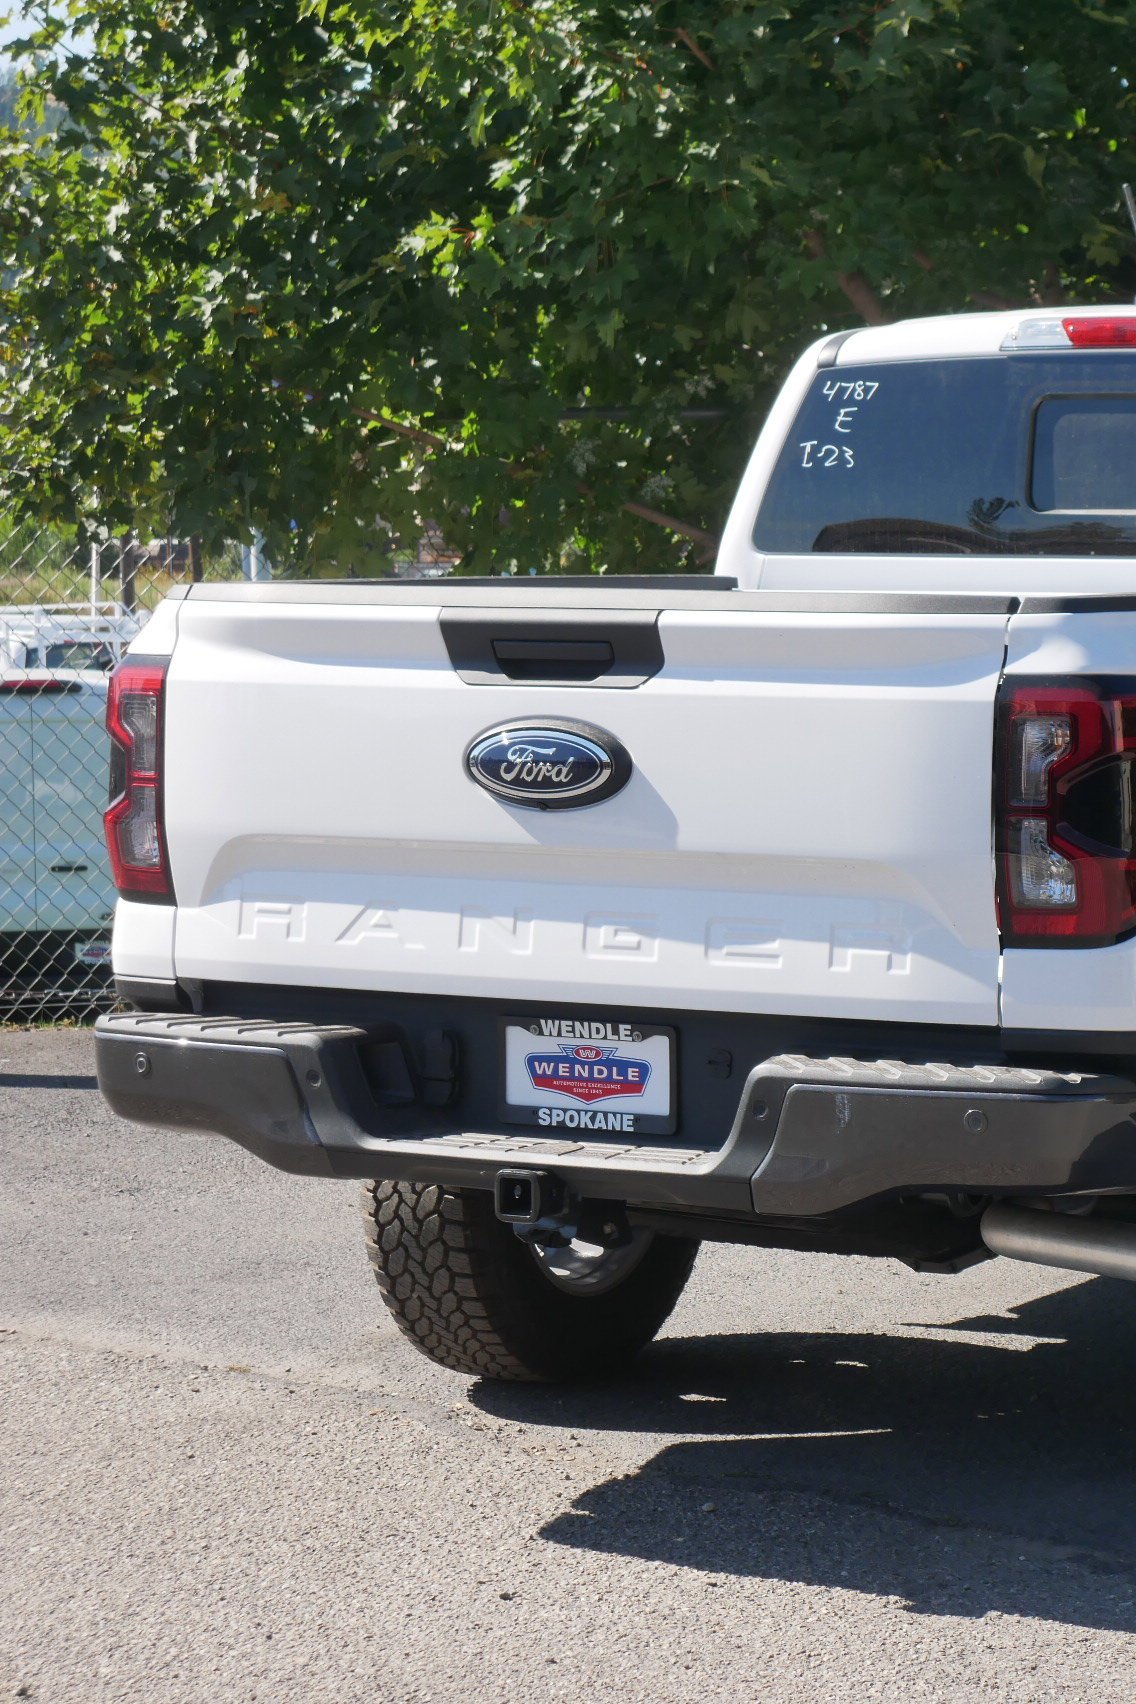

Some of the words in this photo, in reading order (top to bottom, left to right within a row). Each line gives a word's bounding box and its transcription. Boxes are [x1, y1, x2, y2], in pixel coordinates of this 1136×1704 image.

[822, 380, 880, 402] 4787
[835, 407, 858, 433] E
[500, 744, 575, 782] Ford
[237, 892, 912, 976] RANGER
[539, 1018, 634, 1042] WENDLE
[534, 1061, 639, 1081] WENDLE
[538, 1107, 635, 1132] SPOKANE
